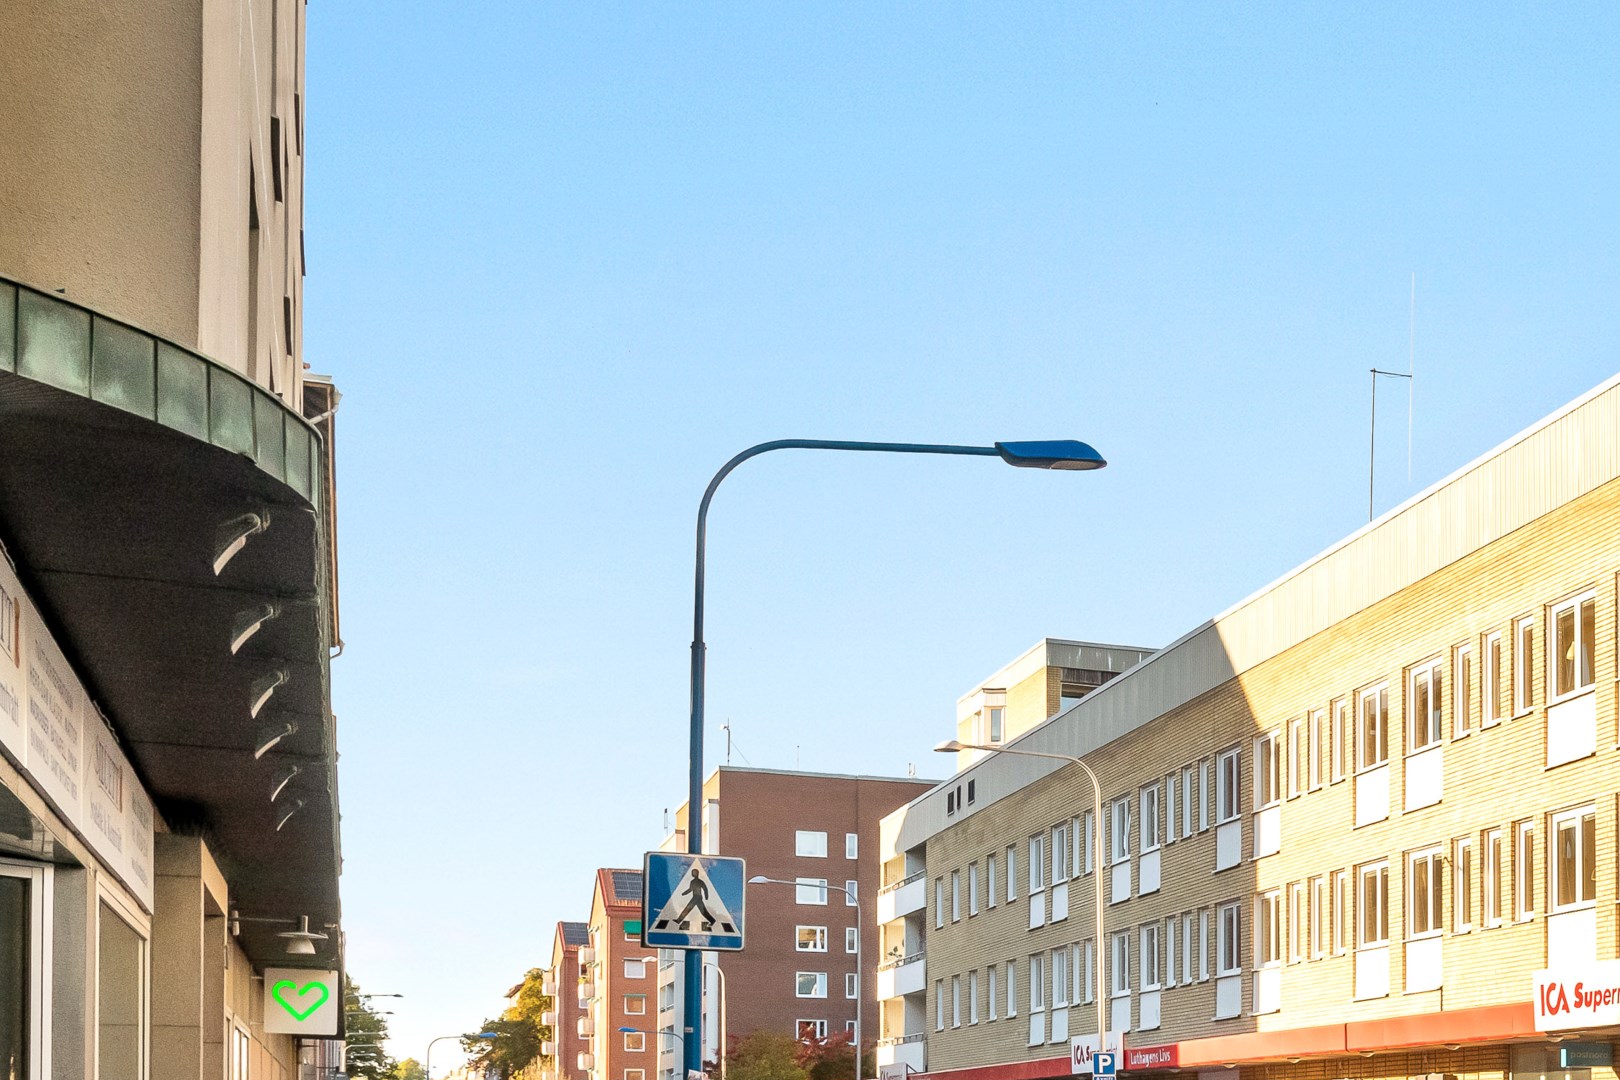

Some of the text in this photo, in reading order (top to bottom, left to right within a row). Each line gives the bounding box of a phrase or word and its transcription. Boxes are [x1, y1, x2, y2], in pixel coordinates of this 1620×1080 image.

[1540, 982, 1570, 1016] ICA
[1074, 1045, 1086, 1065] ICA
[1098, 1055, 1111, 1073] P
[1130, 1051, 1158, 1067] Luthagens
[1159, 1048, 1171, 1062] Livs
